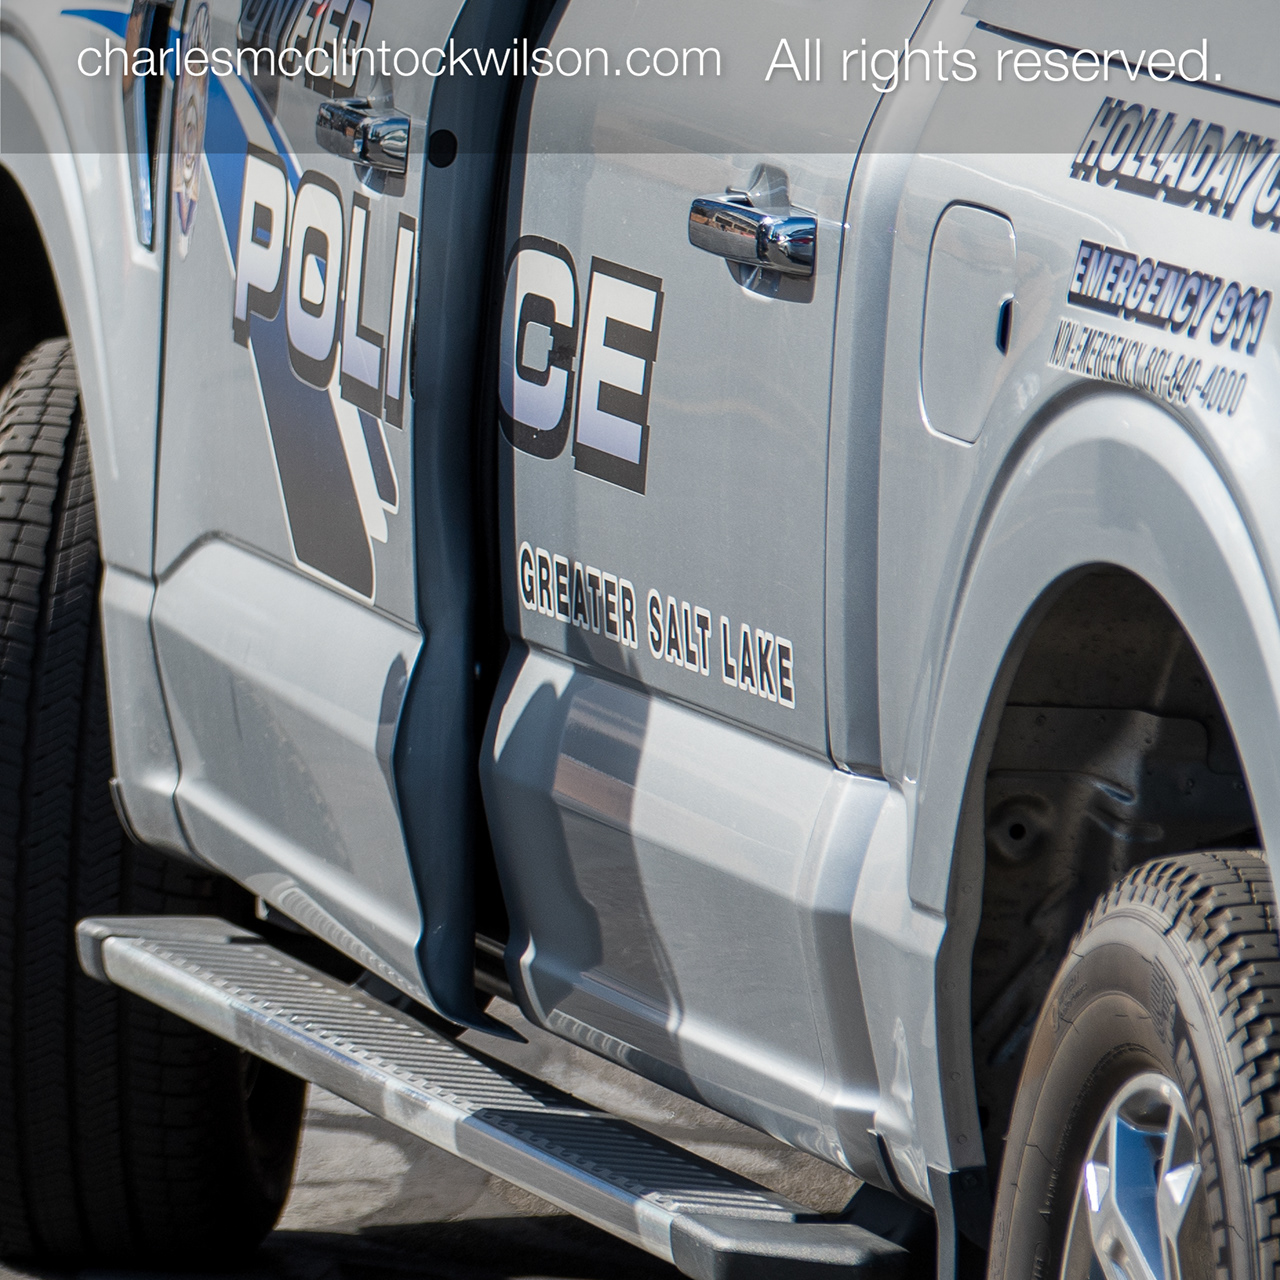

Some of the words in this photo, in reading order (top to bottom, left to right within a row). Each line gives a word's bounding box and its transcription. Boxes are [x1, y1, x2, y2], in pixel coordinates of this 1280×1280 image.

[1070, 96, 1278, 221] HOLLADAY
[232, 141, 664, 495] POLICE
[1066, 239, 1225, 340] EMERGENCY
[1209, 281, 1274, 358] 911
[1047, 318, 1147, 390] NON-EMERGENCY
[1141, 345, 1248, 418] 801-840-4000
[519, 541, 638, 649] GREATER
[647, 588, 712, 676] SALT
[720, 615, 796, 709] LAKE
